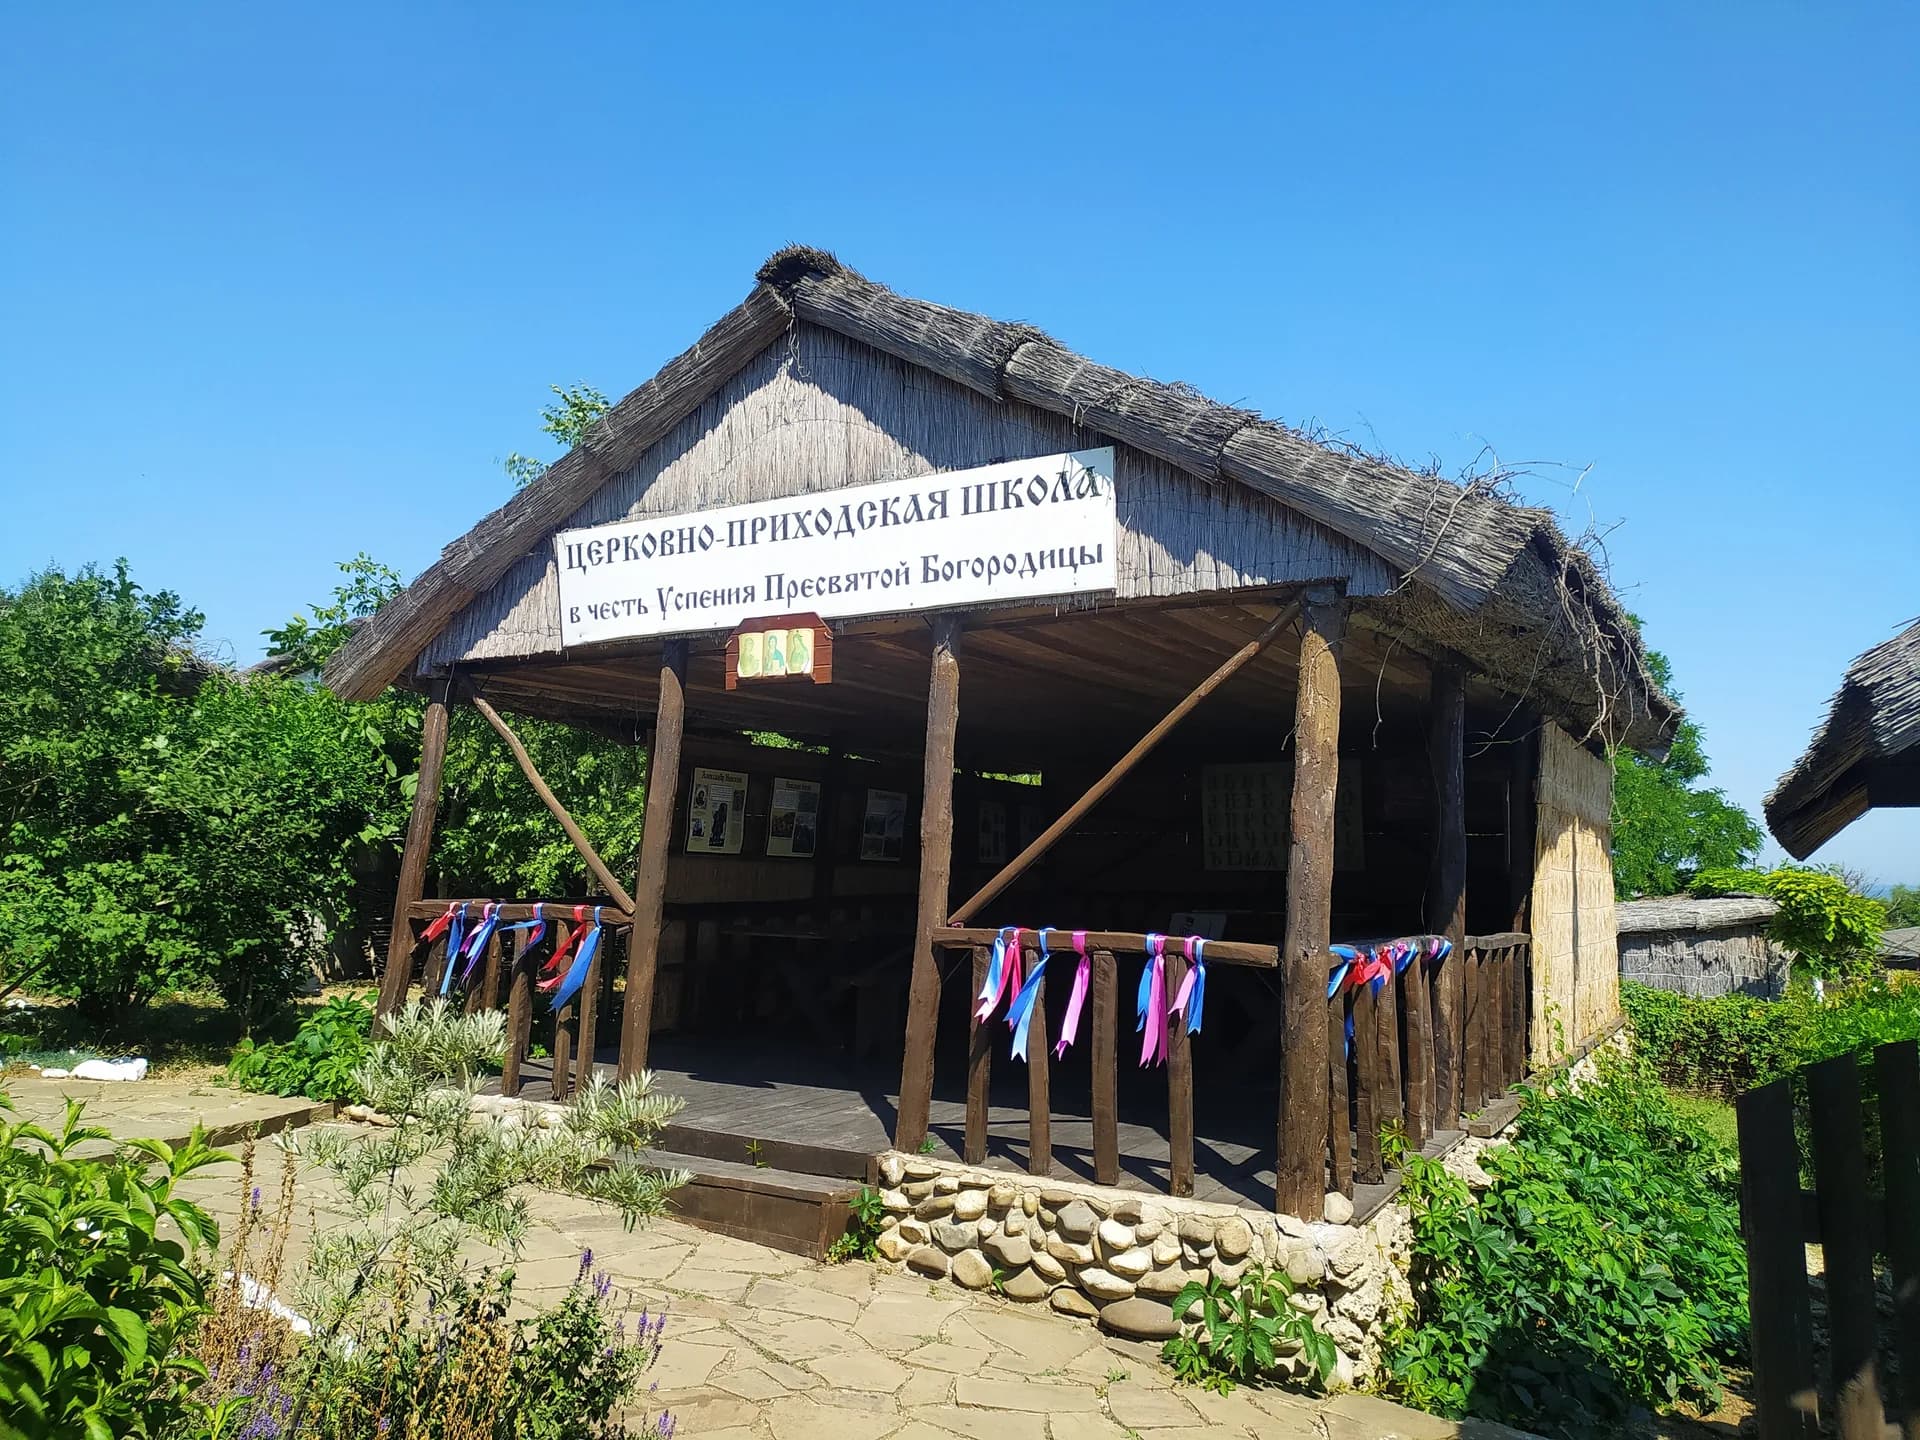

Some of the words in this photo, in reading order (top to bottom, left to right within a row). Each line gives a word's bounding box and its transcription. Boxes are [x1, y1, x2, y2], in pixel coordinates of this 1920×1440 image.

[566, 489, 950, 575] ЦЕРКОВНО-ПРИХОДСКАЯ
[960, 465, 1103, 516] ШКОЛА
[587, 597, 649, 621] честь
[656, 585, 756, 621] Успения
[764, 561, 910, 608] Пресвятой
[920, 543, 1103, 586] Богородицы
